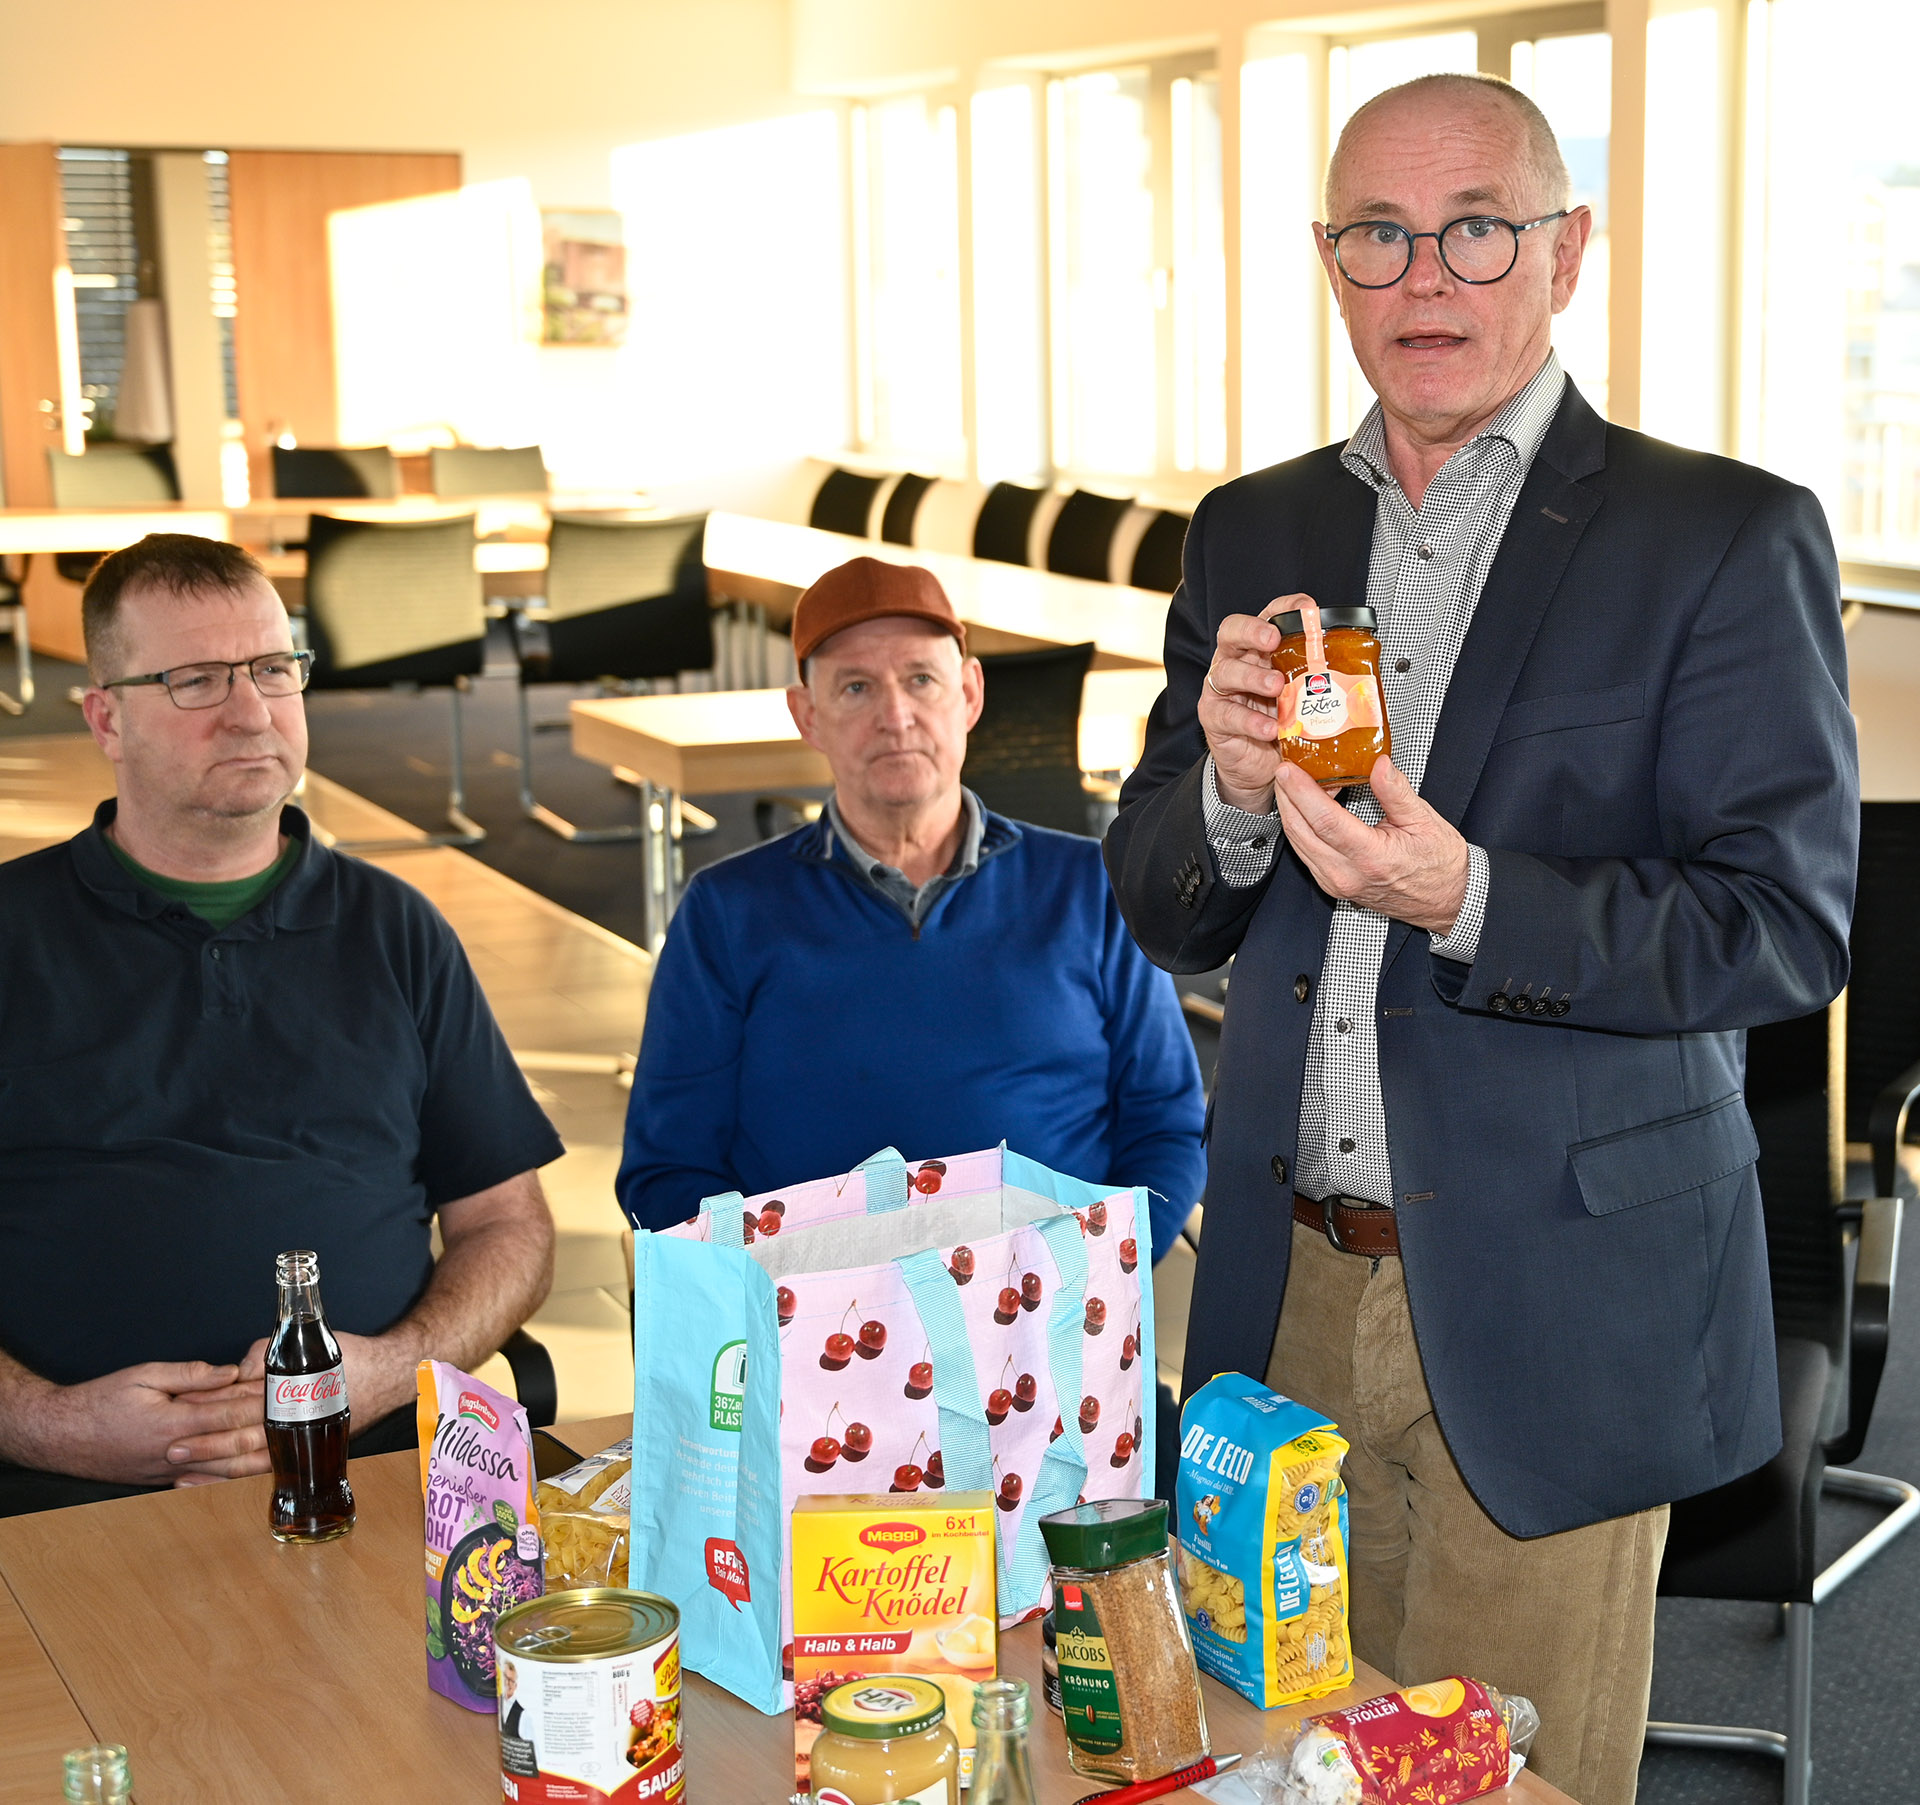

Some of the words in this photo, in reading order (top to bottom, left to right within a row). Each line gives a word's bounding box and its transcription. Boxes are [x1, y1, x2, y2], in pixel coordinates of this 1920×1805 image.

[1300, 696, 1341, 716] Extra
[276, 1369, 342, 1405] Coca-Cola
[303, 1404, 325, 1416] light
[714, 1395, 736, 1411] 36%
[434, 1412, 520, 1482] Mildessa
[1180, 1423, 1216, 1466] DE
[1206, 1436, 1255, 1486] CECCO
[428, 1488, 466, 1523] ROT
[943, 1530, 990, 1538] Kochbeutel
[945, 1515, 976, 1530] 6x1
[867, 1529, 919, 1542] Maggi
[813, 1553, 952, 1605] Kartoffel
[1276, 1544, 1300, 1590] CECCO
[859, 1586, 969, 1626] Knödel
[1279, 1588, 1300, 1612] DE
[803, 1639, 841, 1653] Halb
[844, 1639, 856, 1652] &
[859, 1637, 897, 1652] Halb
[1061, 1643, 1106, 1663] JACOBS
[1064, 1674, 1110, 1689] KRÖNUNG
[852, 1687, 917, 1712] HAK
[1345, 1701, 1400, 1726] STOLLEN
[637, 1753, 686, 1800] SAUER
